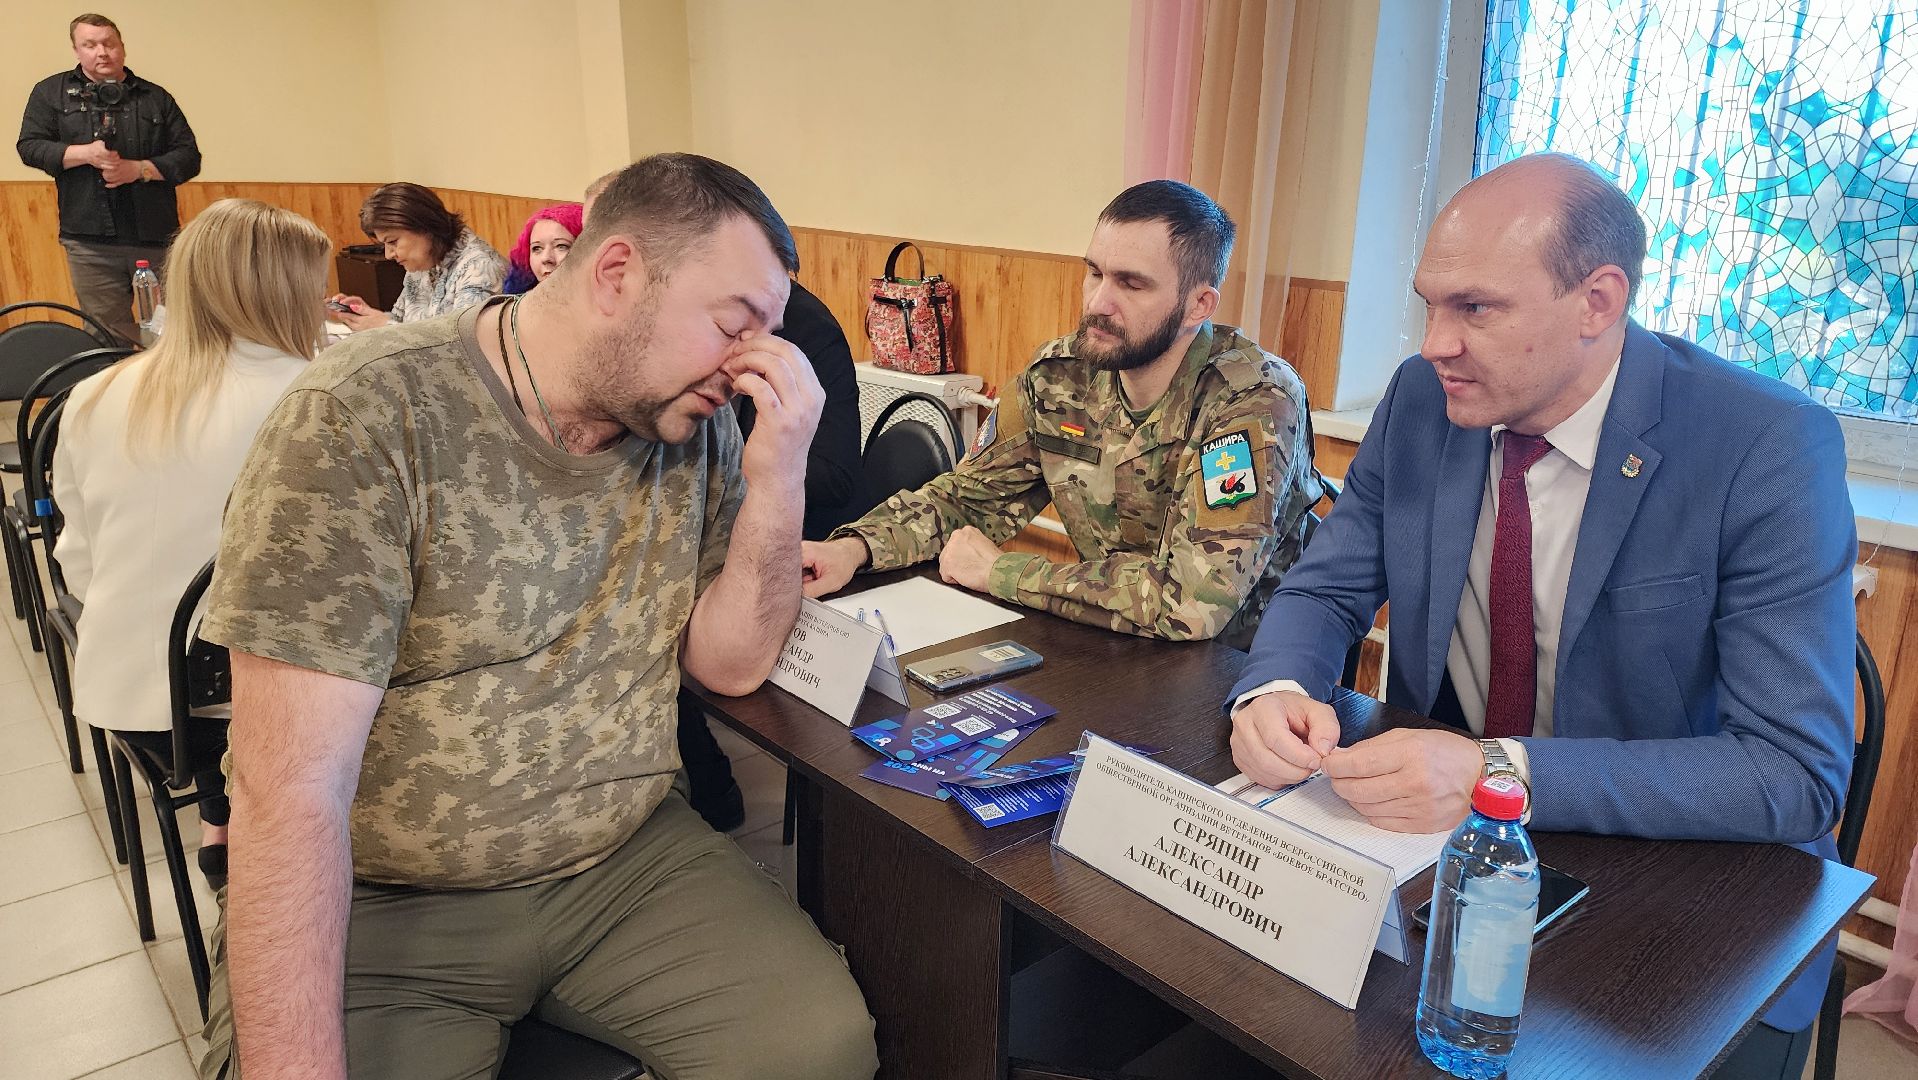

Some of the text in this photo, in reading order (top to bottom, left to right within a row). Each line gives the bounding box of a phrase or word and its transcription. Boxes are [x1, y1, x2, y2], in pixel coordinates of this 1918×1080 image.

[1203, 433, 1245, 454] КАШИРА
[783, 640, 814, 664] САНДР
[793, 627, 807, 641] ОВ
[775, 656, 821, 688] НДРОВИЧ
[1096, 762, 1159, 799] ОБЩЕСТВЕННОЙ
[1160, 793, 1218, 828] ОРГАНИЗАЦИИ
[1219, 823, 1271, 855] ВЕТЕРАНОВ
[1272, 851, 1313, 875] «БОЕВОЕ
[1315, 869, 1370, 903] БРАТСТВО»
[1106, 755, 1364, 887] РУКОВОДИТЕЛЬ КАШИРСКОГО ОТДЕЛЕНИЯ ВСЕРОССИЙСКОЙ
[1173, 817, 1261, 873] СЕРЯПИН
[1124, 844, 1284, 941] АЛЕКСАНДРОВИЧ
[1153, 835, 1264, 901] АЛЕКСАНДР
